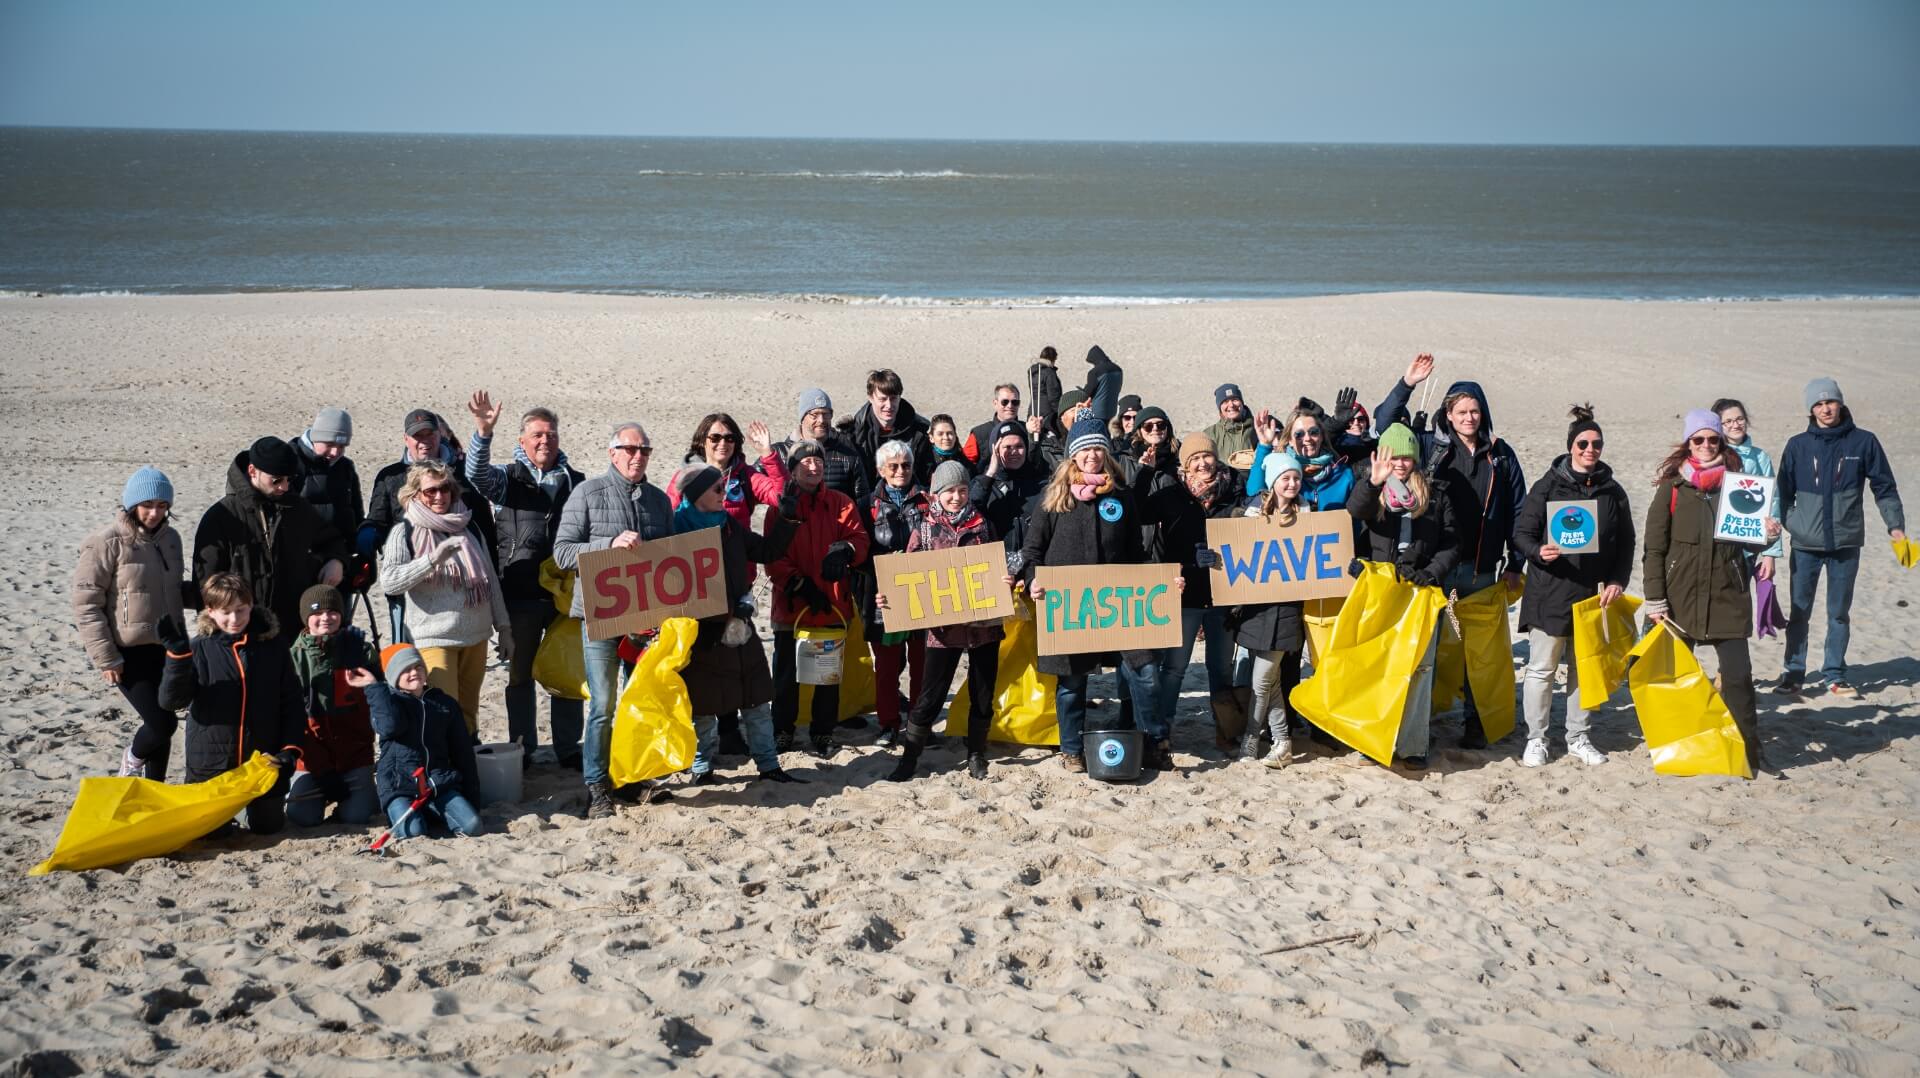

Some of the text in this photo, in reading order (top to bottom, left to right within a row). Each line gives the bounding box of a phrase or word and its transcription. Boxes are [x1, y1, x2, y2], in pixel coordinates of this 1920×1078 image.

[1720, 523, 1763, 537] PLASTIK
[1725, 513, 1761, 527] BYE BYE
[594, 547, 720, 619] STOP
[1220, 532, 1342, 587] WAVE
[894, 562, 997, 620] THE
